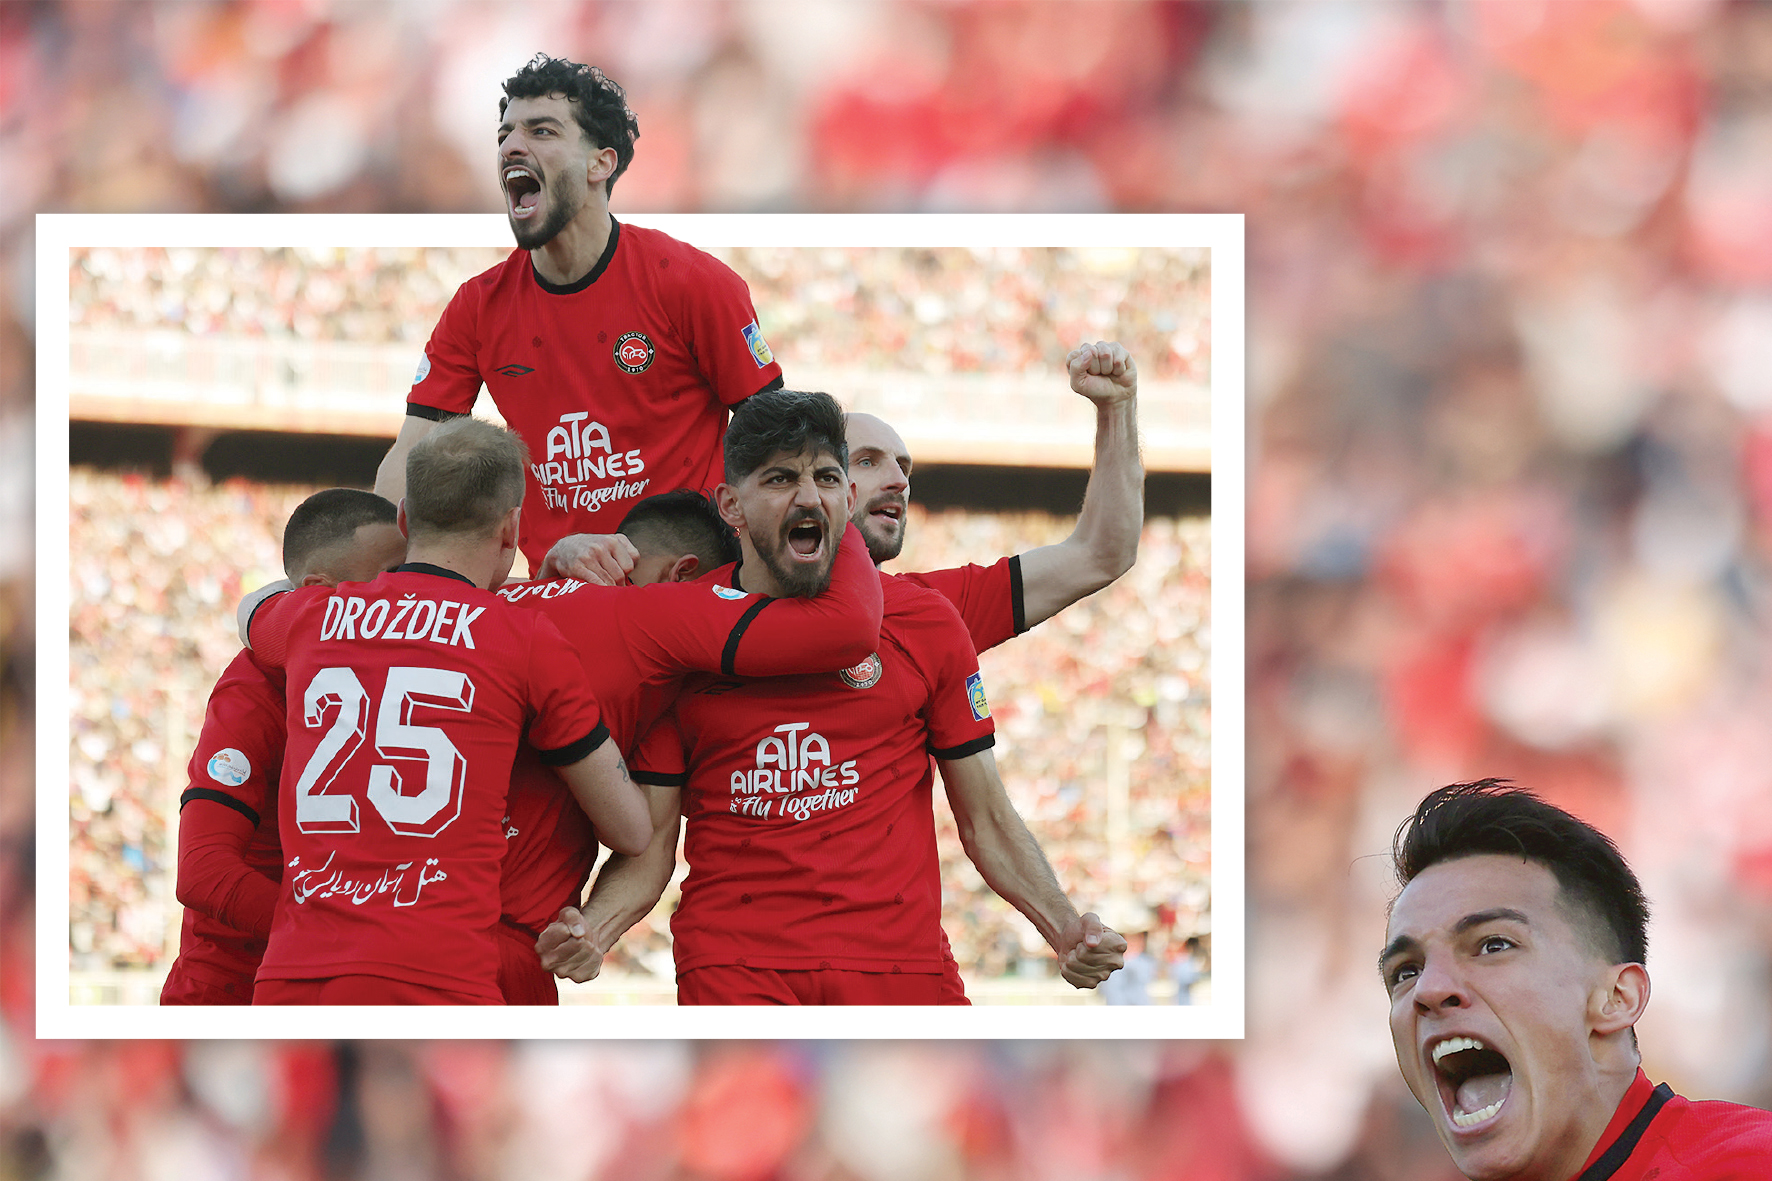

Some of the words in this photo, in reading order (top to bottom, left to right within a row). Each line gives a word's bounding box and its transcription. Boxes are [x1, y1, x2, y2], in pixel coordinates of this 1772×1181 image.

[546, 411, 613, 462] ATA
[531, 449, 645, 485] AIRLINES
[568, 478, 650, 513] Together
[320, 593, 487, 650] DROŽDEK
[296, 666, 476, 839] 25
[756, 721, 831, 771] ATA
[730, 759, 860, 795] AIRLINES
[742, 795, 772, 821] Fly
[777, 787, 859, 821] Together
[393, 857, 448, 908] هتل
